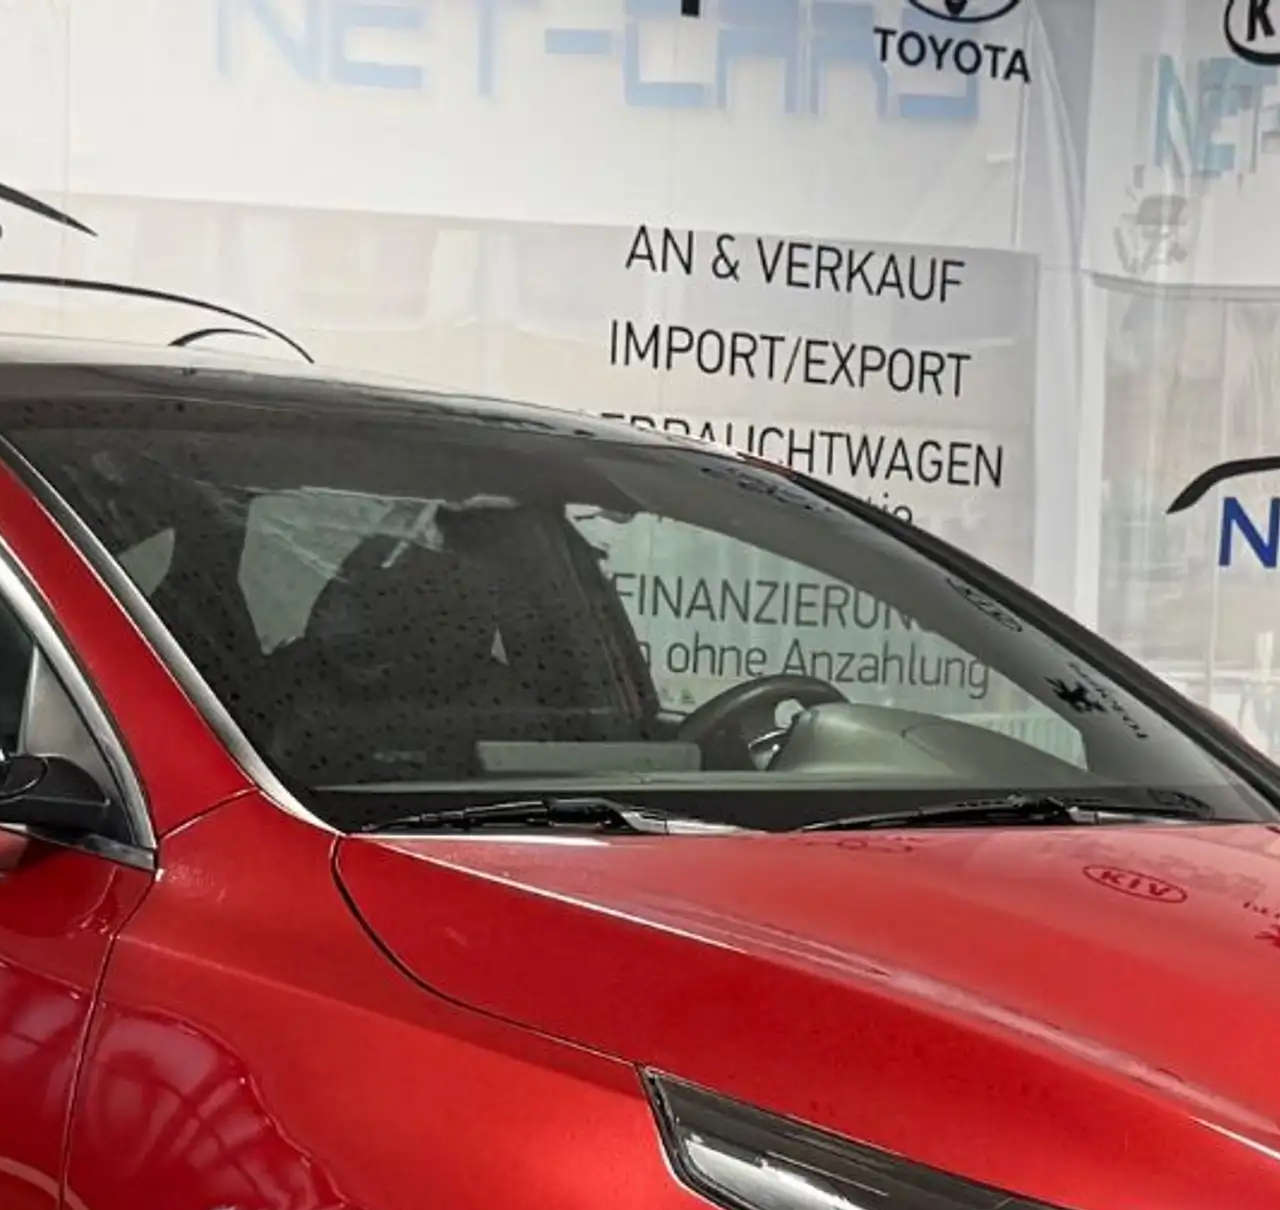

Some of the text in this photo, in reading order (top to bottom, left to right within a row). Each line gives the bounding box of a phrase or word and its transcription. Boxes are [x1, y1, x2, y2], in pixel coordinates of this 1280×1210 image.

[873, 27, 1031, 84] TOYOTA
[625, 225, 966, 303] AN & VERKAUF
[610, 319, 972, 397] IMPORT/EXPORT
[666, 630, 768, 678] ohne
[782, 637, 990, 700] Anzahlung
